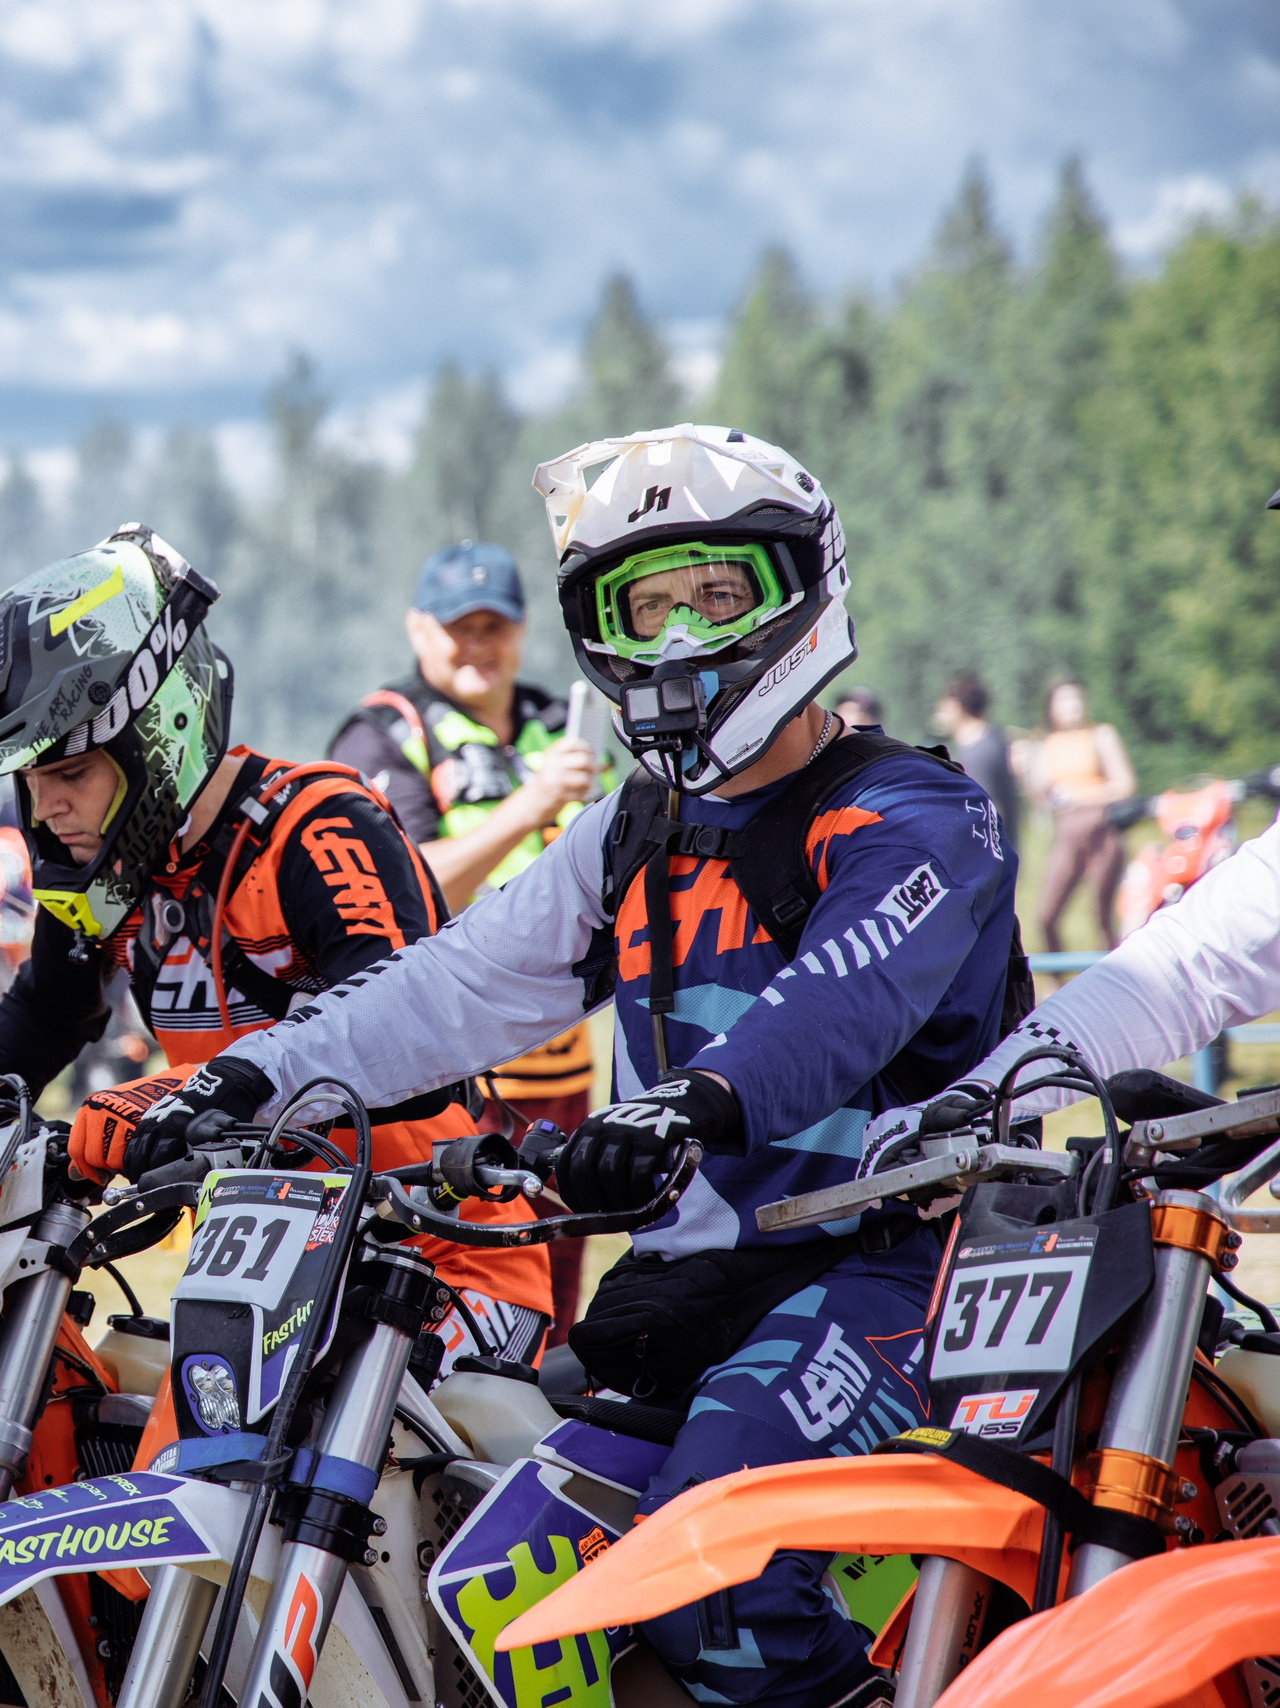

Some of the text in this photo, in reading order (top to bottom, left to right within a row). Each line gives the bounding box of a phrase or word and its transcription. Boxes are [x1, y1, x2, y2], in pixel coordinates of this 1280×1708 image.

[60, 663, 93, 723] RACING
[64, 603, 188, 757] 100%
[758, 626, 819, 697] JUST1
[29, 686, 68, 753] THE ART
[183, 1215, 291, 1282] 361
[943, 1270, 1074, 1352] 377
[911, 1427, 953, 1441] ENDURO
[960, 1394, 1036, 1424] TU
[962, 1591, 985, 1649] XPLOR
